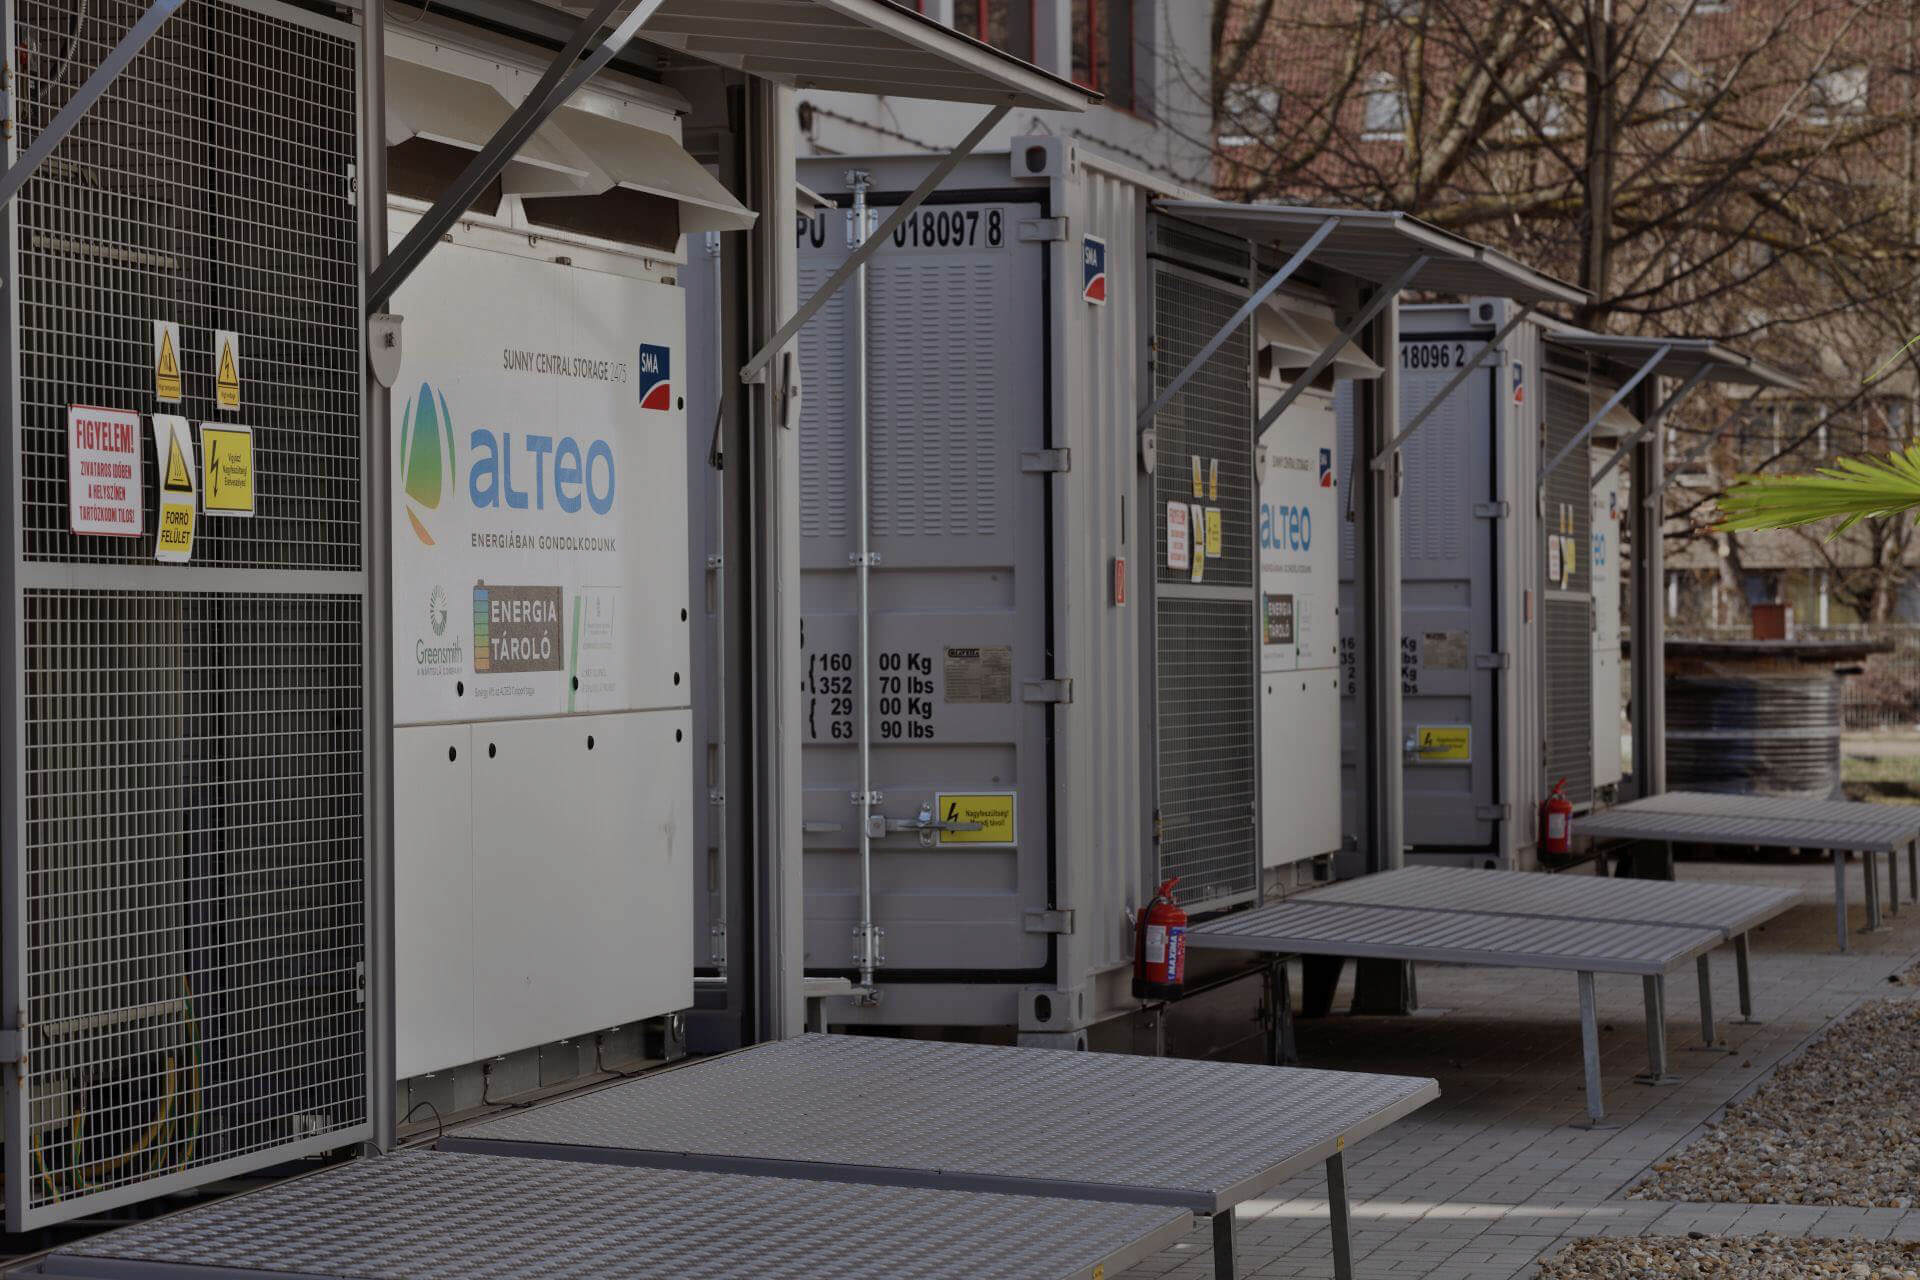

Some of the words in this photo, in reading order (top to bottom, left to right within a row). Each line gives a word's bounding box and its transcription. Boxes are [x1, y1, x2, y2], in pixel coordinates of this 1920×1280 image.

[894, 211, 979, 248] 018097
[988, 210, 1001, 246] 8
[503, 349, 534, 371] SUNNY
[536, 353, 571, 376] CENTRAL
[573, 358, 608, 380] STORAGE
[641, 352, 658, 373] SMA
[1455, 344, 1465, 368] 2
[76, 419, 135, 453] FIGYELEM!
[80, 461, 111, 478] ZIVATAROS
[88, 484, 92, 499] A
[166, 509, 189, 525] FORRÓ
[160, 530, 190, 545] FELÜLET
[471, 531, 535, 549] ENERGIÁBAN
[538, 535, 616, 551] GONDOLKODUNK
[491, 600, 557, 623] ENERGIA
[416, 634, 463, 664] Greensmith
[491, 630, 551, 661] TÁROLÓ
[907, 653, 932, 675] Kg
[908, 676, 934, 694] lbs
[908, 698, 932, 719] Kg
[908, 721, 935, 739] lbs
[1169, 935, 1177, 975] MAXIMA
